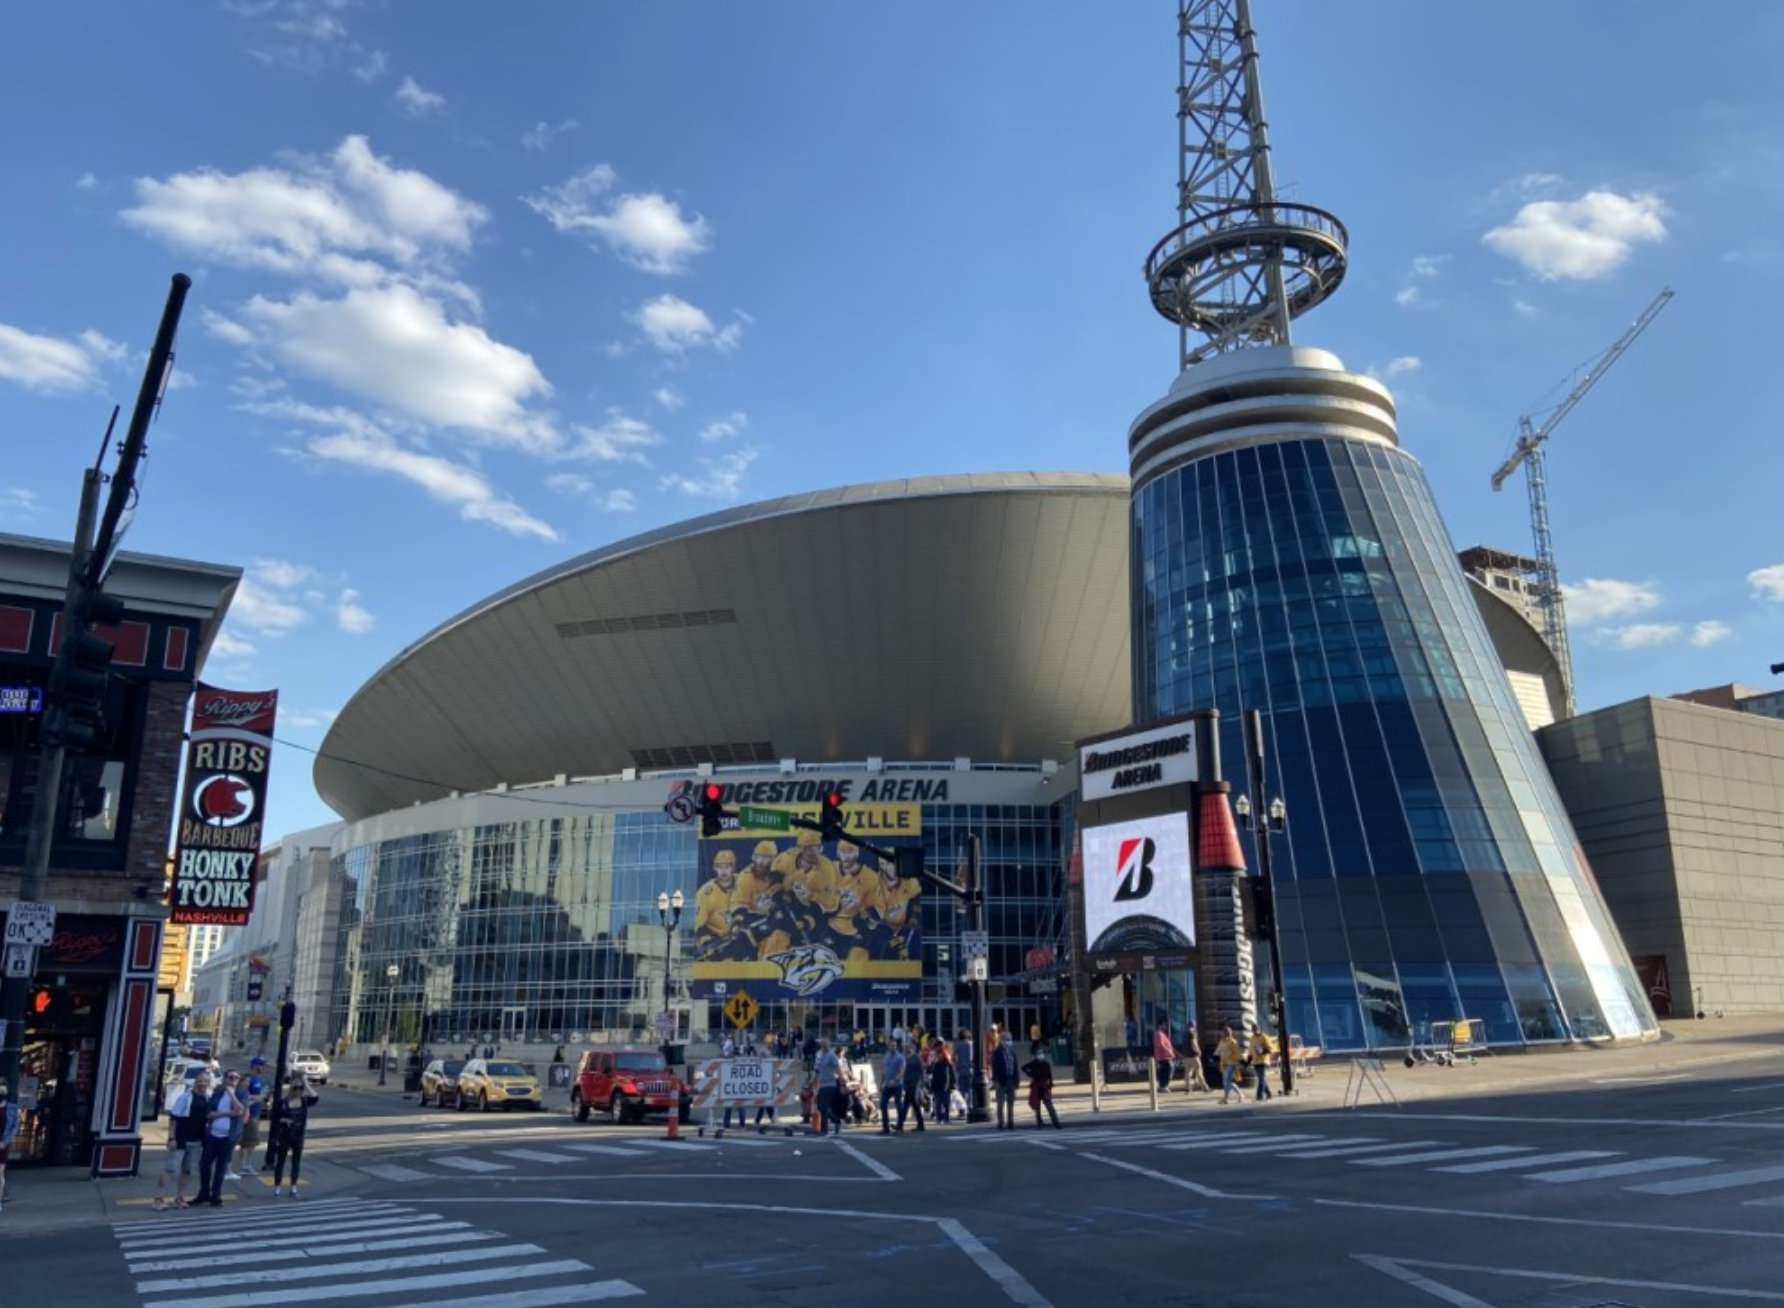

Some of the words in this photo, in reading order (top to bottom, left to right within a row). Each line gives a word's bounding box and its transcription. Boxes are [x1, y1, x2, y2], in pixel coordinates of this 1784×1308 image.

[201, 692, 275, 720] Rippy's
[194, 741, 265, 773] RIBS
[1083, 733, 1192, 774] BRIDGESTONE
[1111, 762, 1162, 789] ARENA
[668, 778, 852, 805] BRDGESTONE
[860, 779, 949, 801] ARENA
[182, 818, 260, 849] BARBEQUE
[178, 848, 255, 880] HONKY
[177, 880, 251, 908] TONK
[8, 922, 27, 938] OK
[174, 911, 246, 924] NASHVILLE
[730, 1067, 762, 1079] ROAD
[724, 1081, 770, 1096] CLOSED
